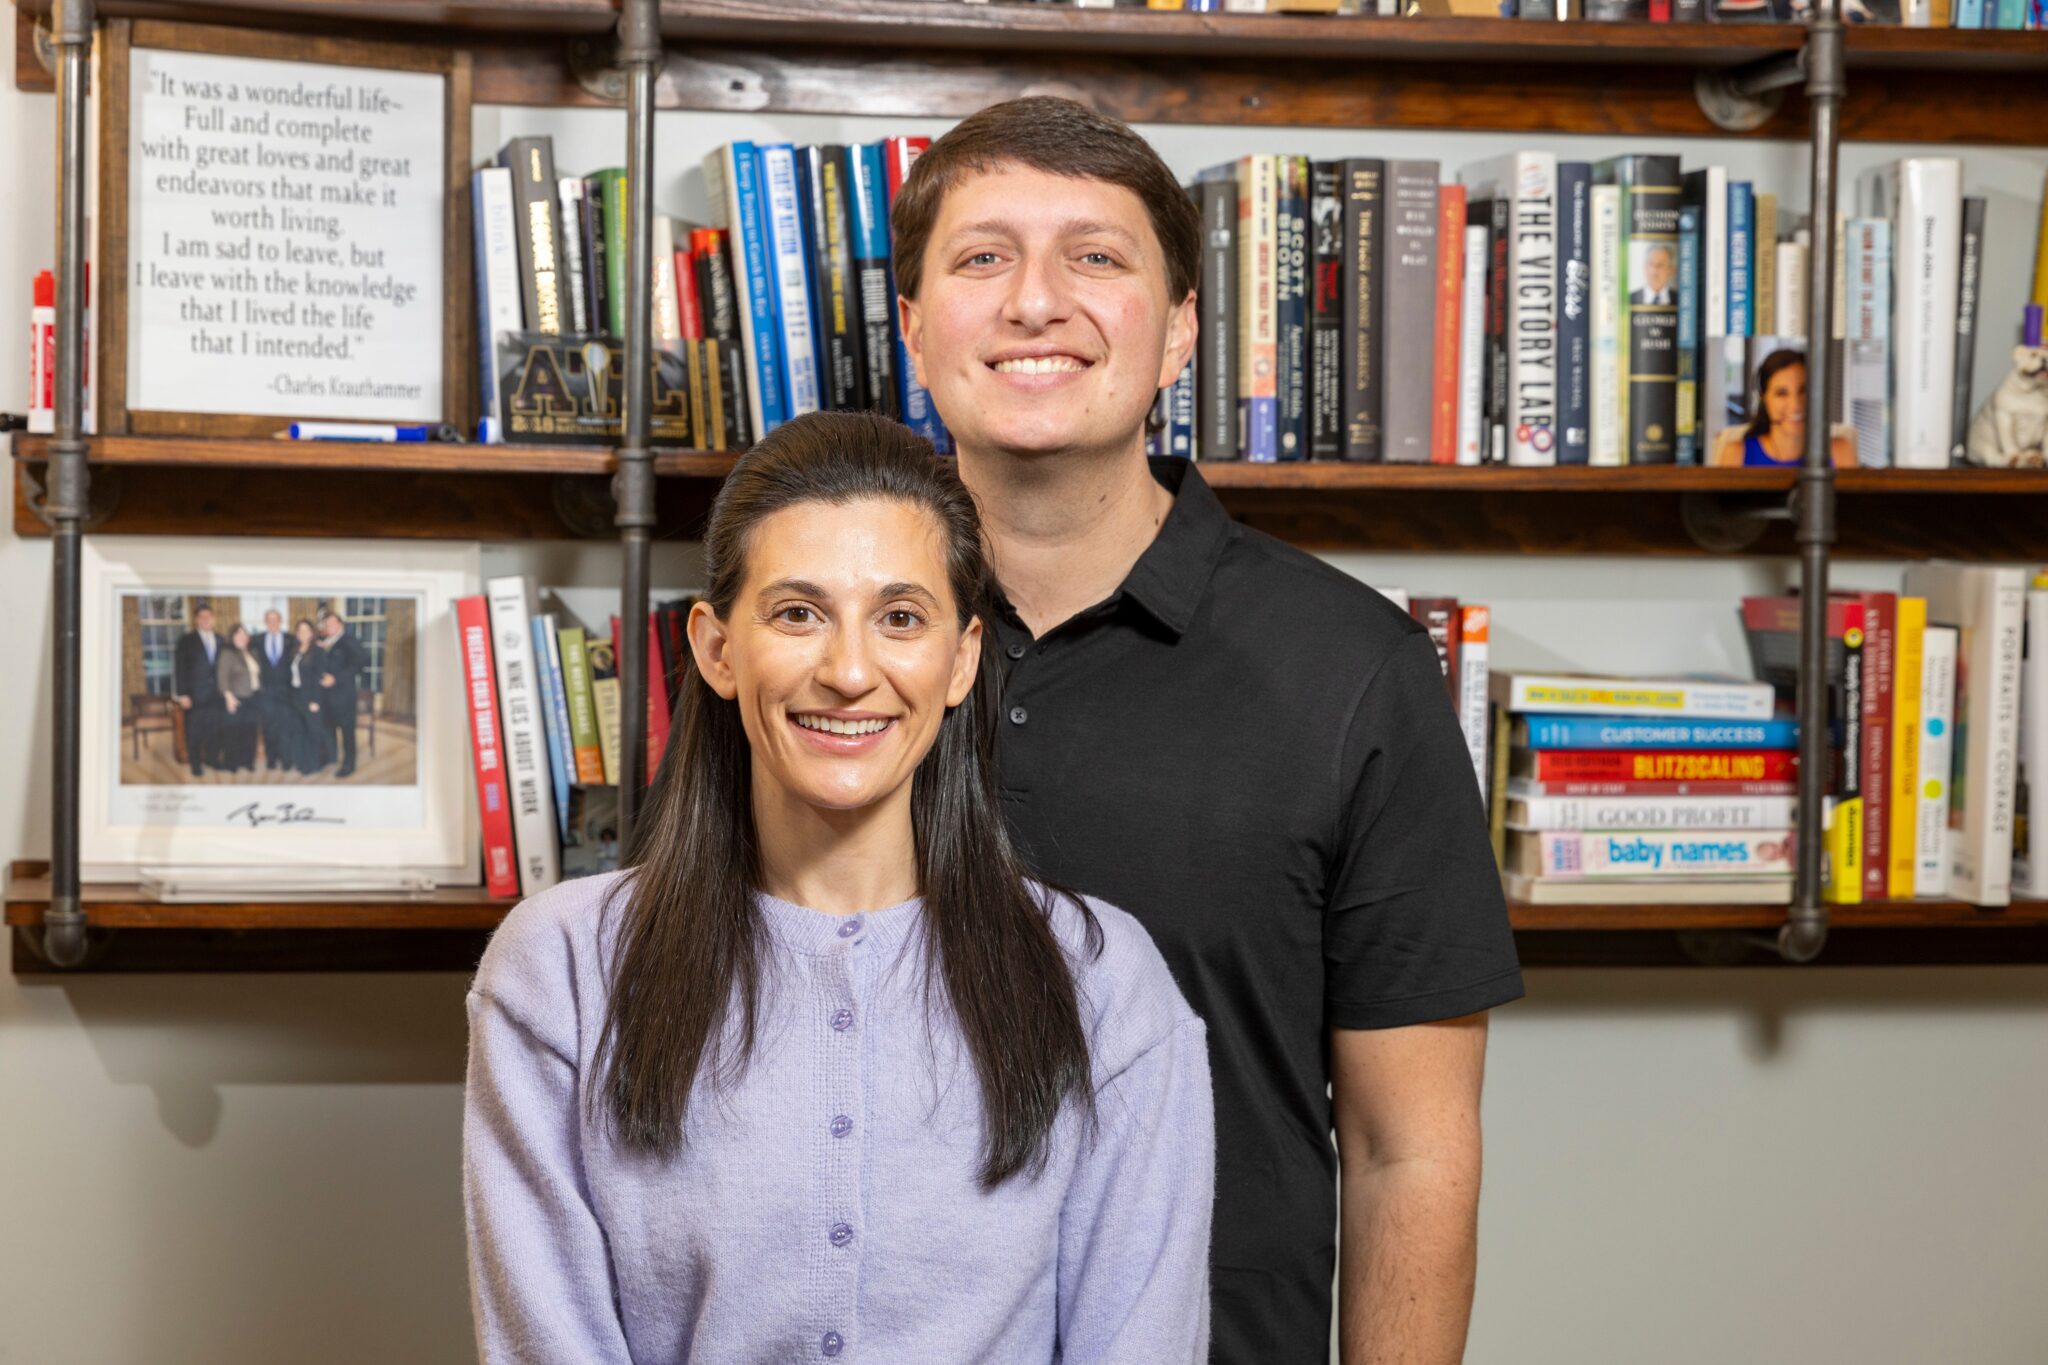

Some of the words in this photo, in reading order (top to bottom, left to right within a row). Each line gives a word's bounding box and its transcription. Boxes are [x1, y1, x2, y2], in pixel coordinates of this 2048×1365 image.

[149, 70, 175, 97] "It
[181, 80, 223, 101] was
[226, 83, 240, 102] a
[245, 82, 353, 111] wonderful
[184, 104, 225, 132] Full
[229, 109, 270, 136] and
[275, 115, 373, 148] complete
[139, 135, 190, 161] with
[195, 145, 249, 170] great
[256, 142, 311, 171] loves
[314, 144, 355, 174] and
[359, 156, 411, 180] great
[739, 161, 753, 188] Keep
[155, 169, 266, 199] endeavors
[271, 174, 313, 202] that
[320, 177, 377, 207] make
[382, 188, 397, 207] it
[211, 204, 275, 230] worth
[281, 206, 344, 242] living.
[742, 193, 756, 226] Trying
[1520, 197, 1552, 243] THE
[163, 231, 170, 257] I
[175, 239, 210, 258] am
[214, 235, 252, 261] sad
[257, 242, 280, 262] to
[285, 235, 345, 267] leave,
[350, 241, 385, 268] but
[1924, 216, 1935, 248] Steve
[749, 241, 761, 276] Catch
[1278, 213, 1290, 300] BROWN
[1291, 217, 1304, 297] SCOTT
[1923, 252, 1934, 278] Jobs
[134, 260, 143, 289] I
[150, 261, 206, 290] leave
[210, 267, 259, 293] with
[264, 268, 299, 295] the
[305, 270, 417, 307] knowledge
[831, 267, 843, 292] THE
[180, 298, 223, 323] that
[231, 298, 238, 324] I
[245, 299, 296, 326] lived
[301, 301, 337, 329] the
[341, 303, 375, 330] life
[833, 295, 846, 334] GAME
[1519, 257, 1552, 371] VICTORY
[1633, 315, 1677, 326] GEORGE
[190, 328, 233, 355] that
[241, 330, 249, 356] I
[255, 333, 364, 360] intended."
[1640, 338, 1671, 349] BUSH
[329, 377, 422, 400] Krauthammer
[1520, 382, 1552, 427] LAB
[465, 625, 487, 678] FREEZING
[1864, 609, 1879, 713] KRAUTHAMMER
[1879, 629, 1892, 692] CHARLES
[507, 660, 525, 689] NINE
[1844, 654, 1860, 690] Supply
[2000, 626, 2015, 722] PORTRAITS
[473, 680, 491, 708] COLD
[510, 697, 529, 724] LIES
[601, 684, 617, 716] THE
[1845, 692, 1859, 720] Chain
[514, 731, 534, 771] ABOUT
[1600, 726, 1690, 742] CUSTOMER
[1693, 727, 1764, 743] SUCCESS
[1869, 727, 1883, 769] THINGS
[481, 750, 498, 771] NFL
[1633, 755, 1765, 780] BLITZSCALING
[1844, 722, 1859, 791] Management
[520, 778, 539, 815] WORK
[1868, 774, 1883, 804] THAT
[1994, 752, 2012, 832] COURAGE
[1597, 806, 1667, 826] GOOD
[1671, 806, 1752, 826] PROFIT
[1867, 808, 1882, 856] MATTER
[1607, 837, 1663, 869] baby
[1672, 841, 1748, 862] names
